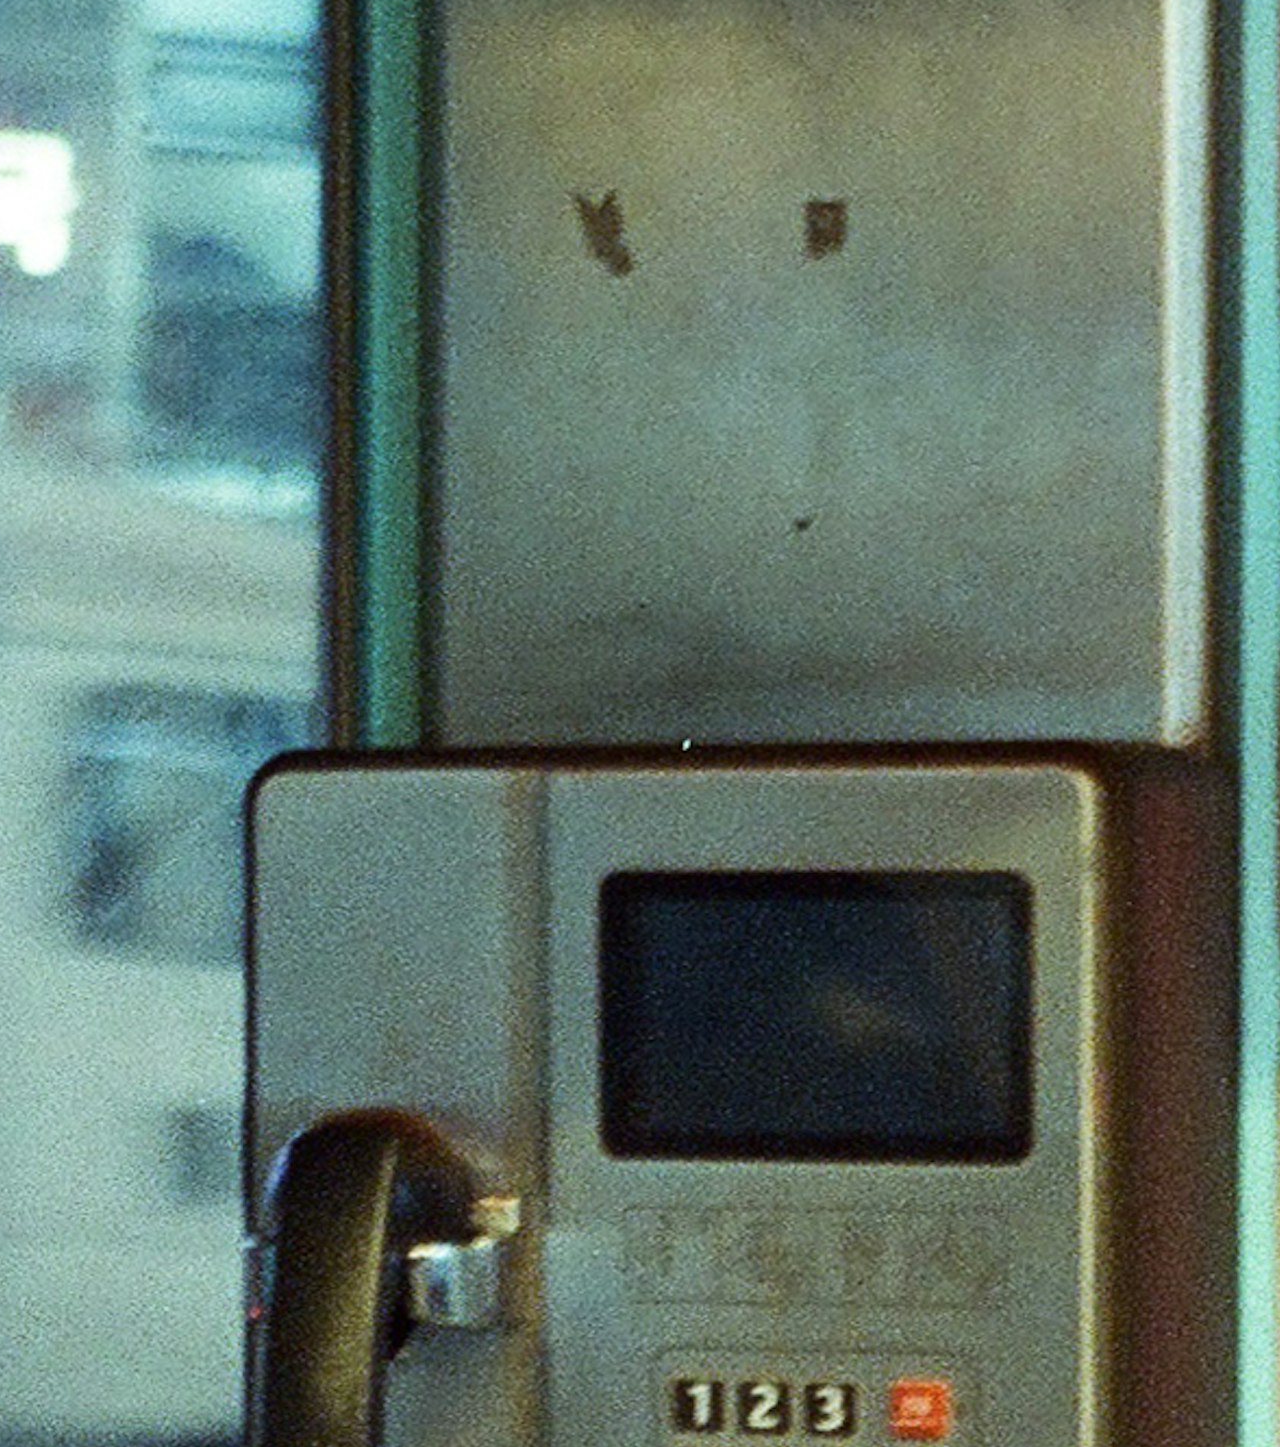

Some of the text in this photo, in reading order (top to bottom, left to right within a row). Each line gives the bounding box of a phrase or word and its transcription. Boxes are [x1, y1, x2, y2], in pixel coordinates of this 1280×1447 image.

[689, 1382, 711, 1425] 1
[748, 1384, 779, 1429] 2
[816, 1386, 845, 1432] 3
